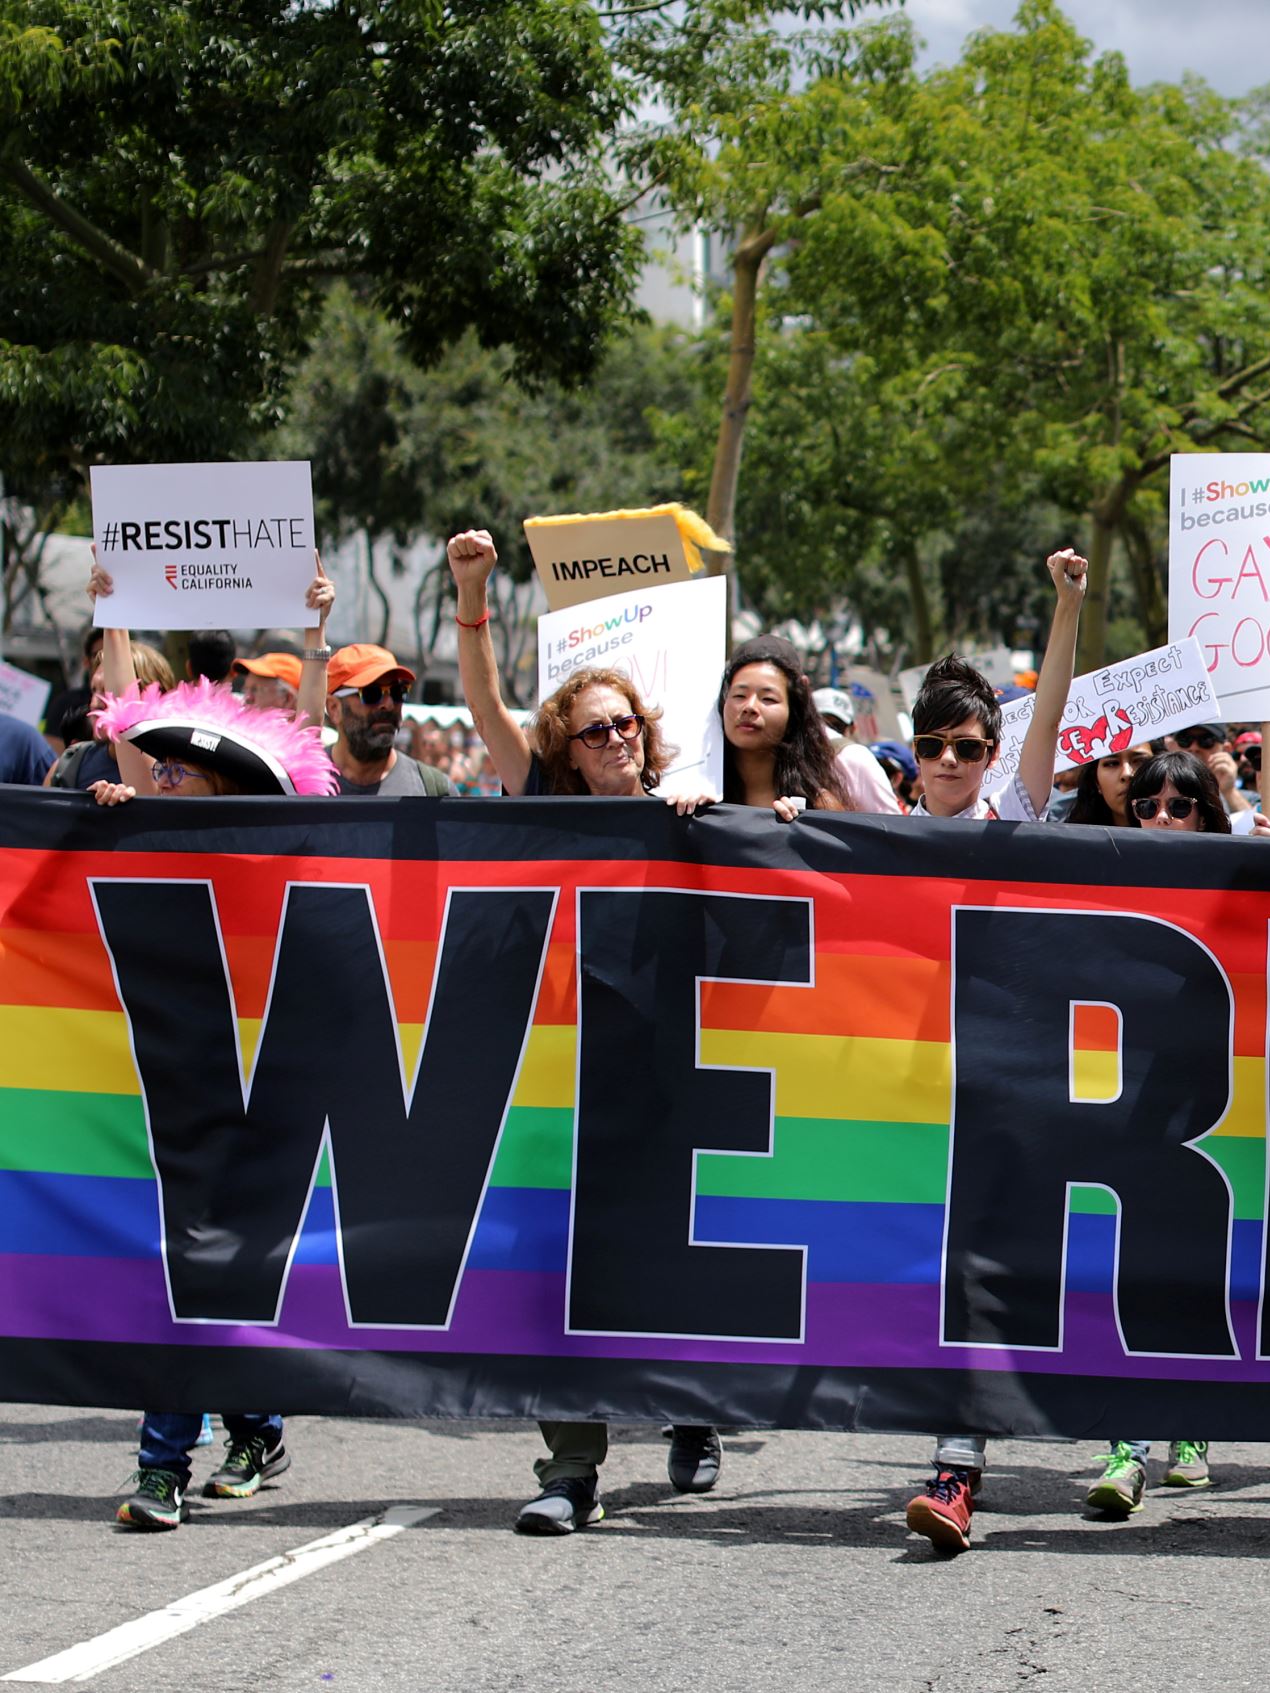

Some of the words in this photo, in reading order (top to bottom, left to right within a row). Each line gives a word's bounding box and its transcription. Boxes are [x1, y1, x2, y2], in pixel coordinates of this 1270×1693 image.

[1181, 487, 1186, 507] I
[101, 518, 307, 551] #RESISTHATE
[181, 563, 238, 576] EQUALITY
[551, 553, 671, 582] IMPEACH
[182, 577, 253, 590] CALIFORNIA
[547, 642, 552, 660] I
[557, 605, 653, 651] #ShowUp
[547, 631, 634, 680] because
[86, 876, 815, 1345] WE
